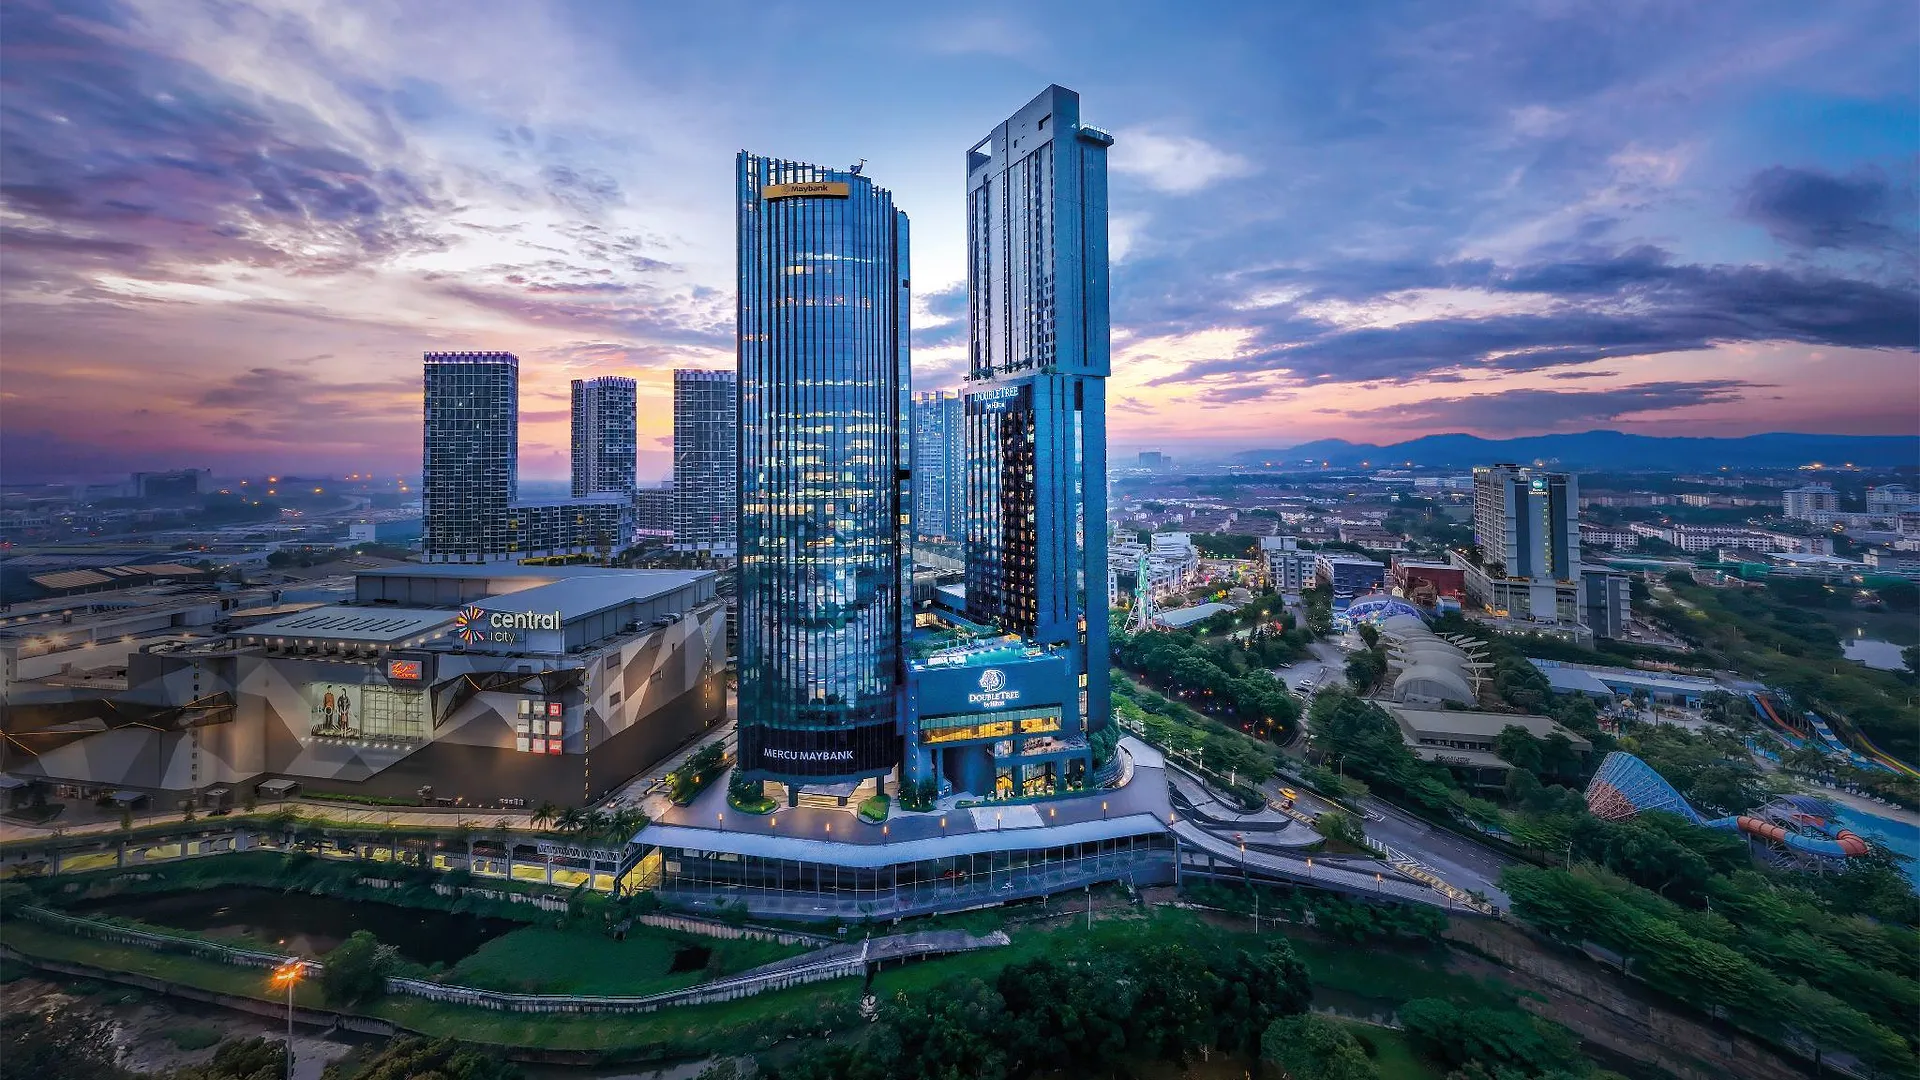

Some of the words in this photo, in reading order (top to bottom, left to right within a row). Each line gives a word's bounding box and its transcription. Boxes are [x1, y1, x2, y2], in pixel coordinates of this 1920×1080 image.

[791, 184, 828, 193] Maybank
[490, 610, 561, 630] central
[763, 748, 798, 760] MERCU
[799, 750, 854, 761] MAYBANK
